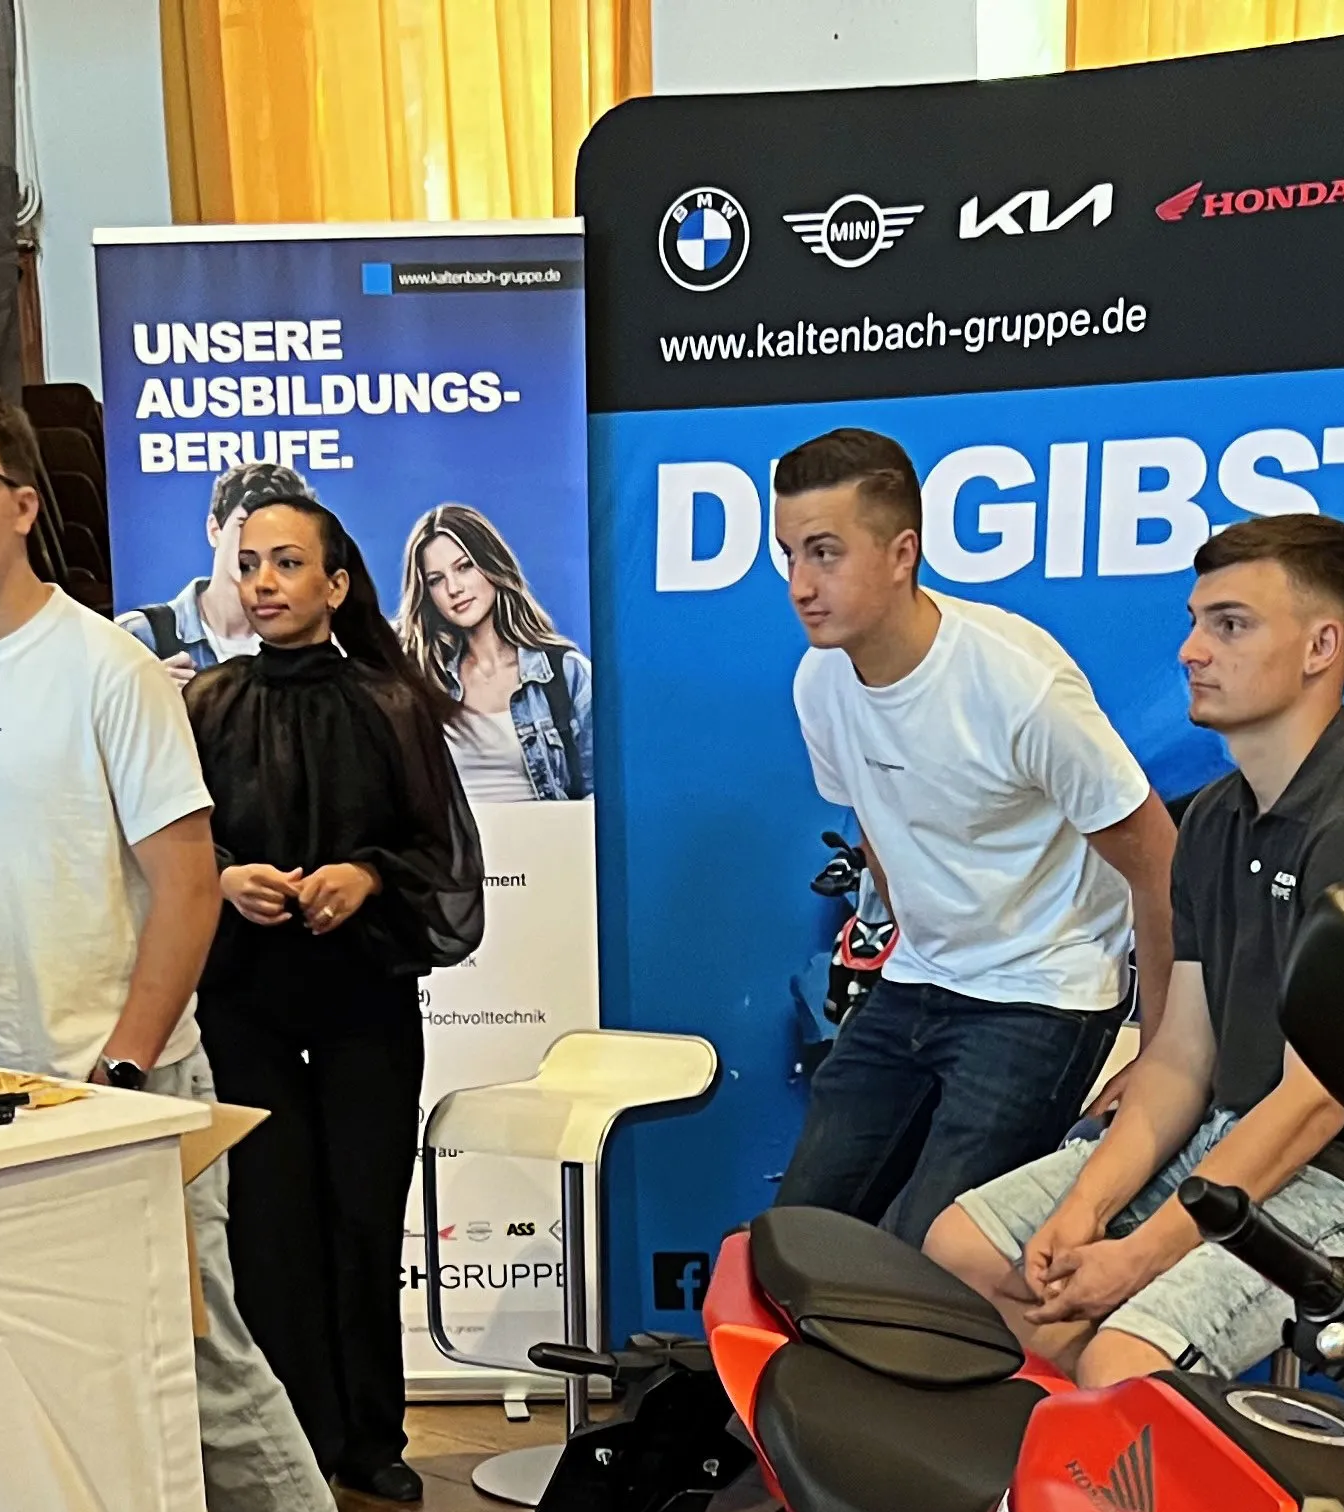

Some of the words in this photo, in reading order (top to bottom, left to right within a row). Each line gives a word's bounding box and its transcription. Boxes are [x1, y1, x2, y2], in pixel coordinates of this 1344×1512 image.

[830, 220, 877, 242] MINI
[398, 268, 561, 287] www.kaltenbach-gruppe.de
[133, 319, 343, 365] UNSERE
[659, 297, 1148, 363] www.kaltenbach-gruppe.de
[135, 371, 521, 419] AUSBILDUNGS-
[139, 428, 354, 473] BERUFE.
[655, 458, 789, 593] D
[485, 873, 527, 887] ment
[506, 1222, 536, 1237] ASS
